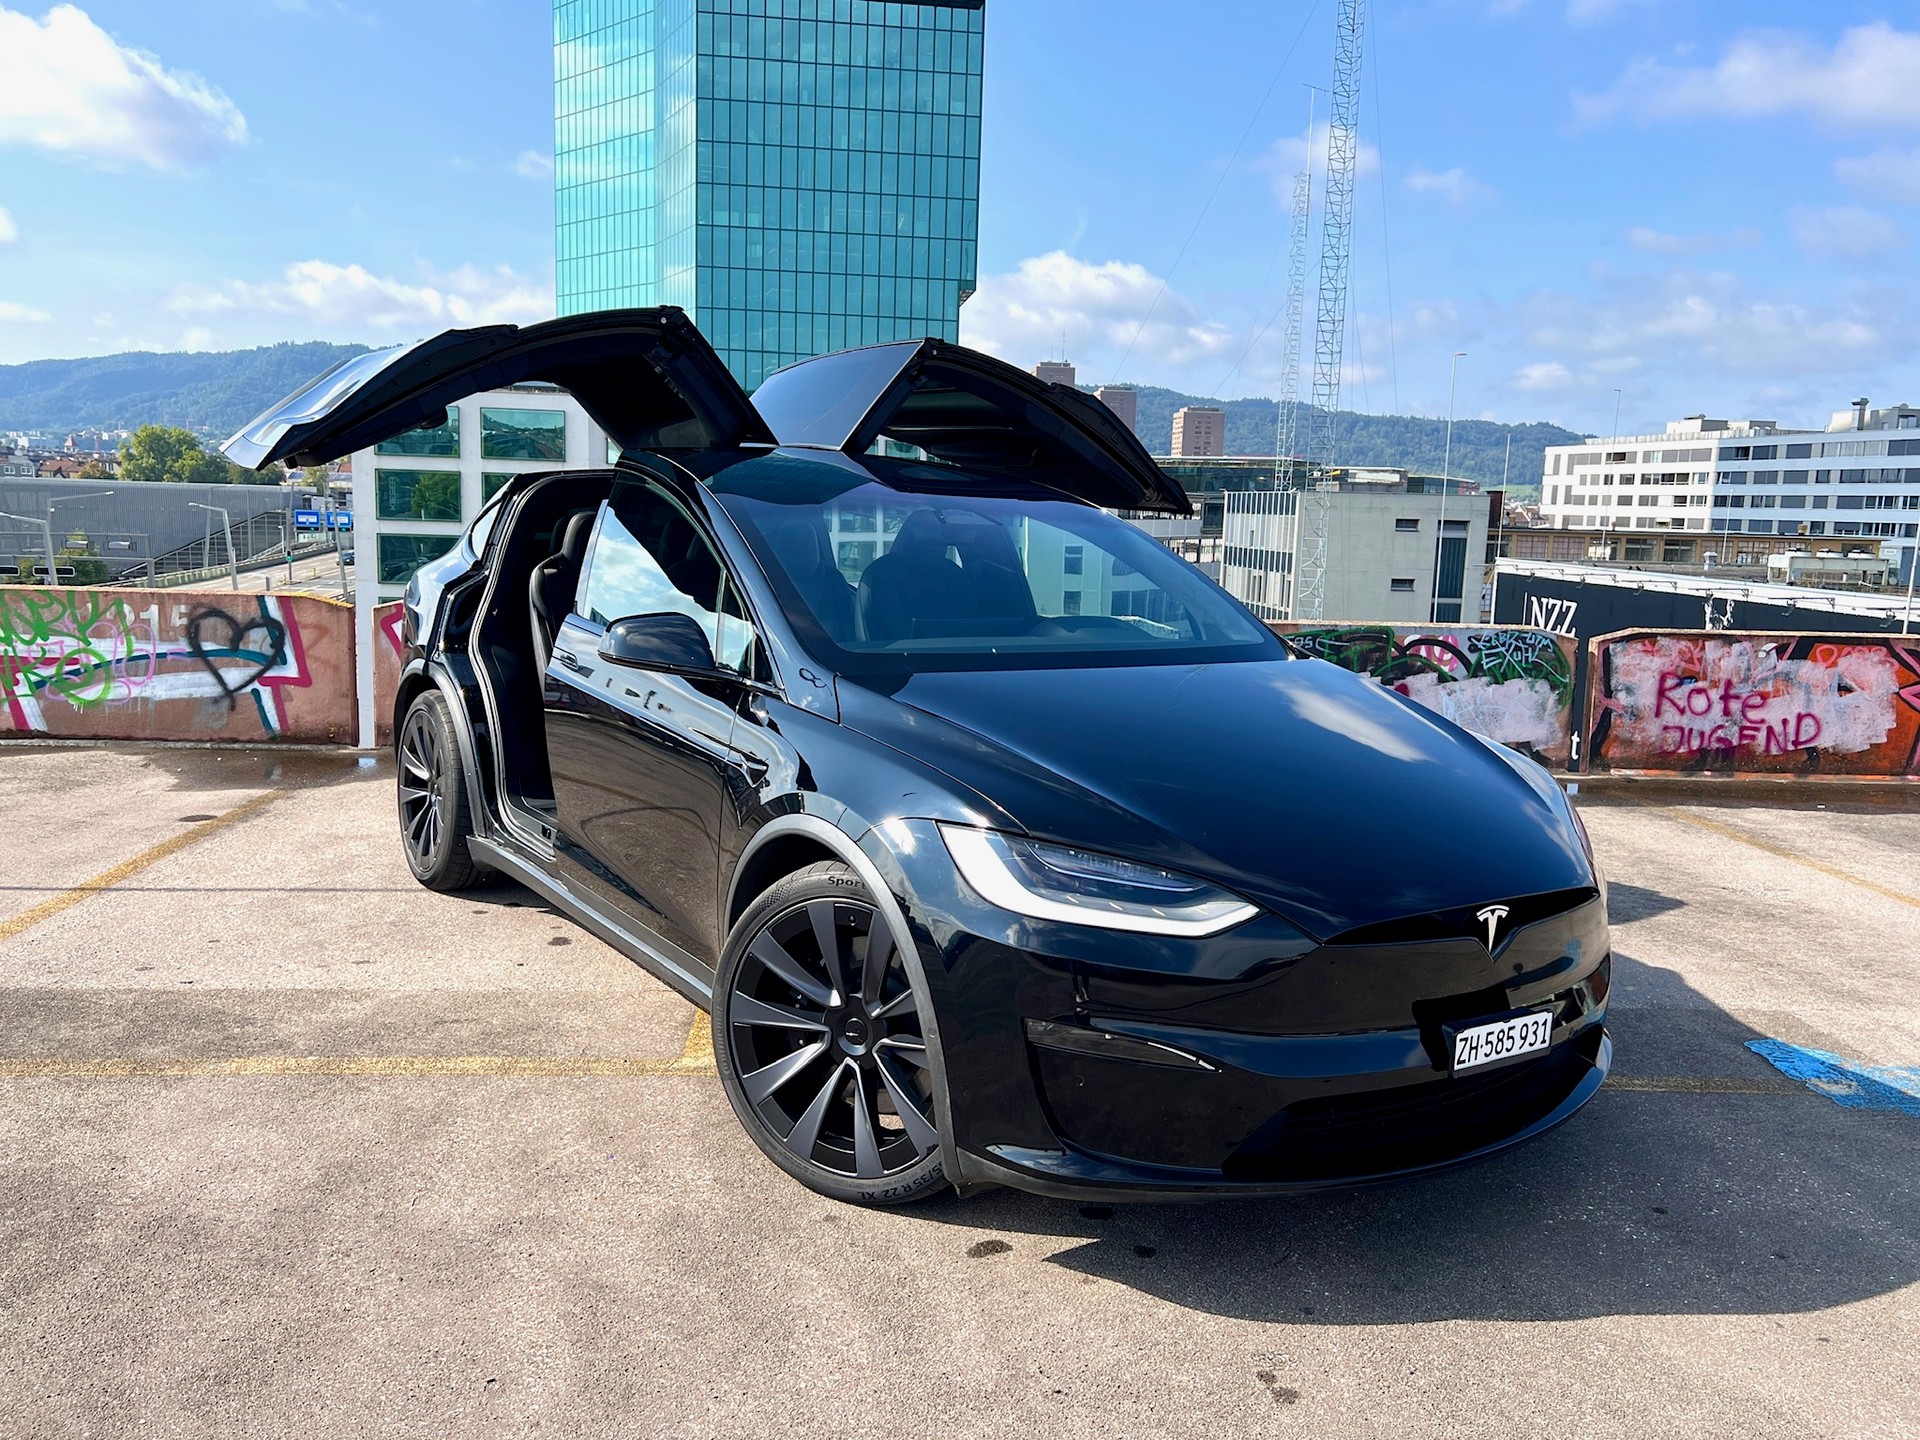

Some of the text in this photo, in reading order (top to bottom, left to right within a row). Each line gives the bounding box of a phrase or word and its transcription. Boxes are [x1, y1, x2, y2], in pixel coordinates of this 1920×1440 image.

[1530, 596, 1578, 637] NZZ
[1653, 712, 1822, 755] JUGEND
[828, 876, 866, 890] Sport
[1518, 1018, 1548, 1050] 931
[857, 1160, 943, 1200] 5/35 R 22 XL
